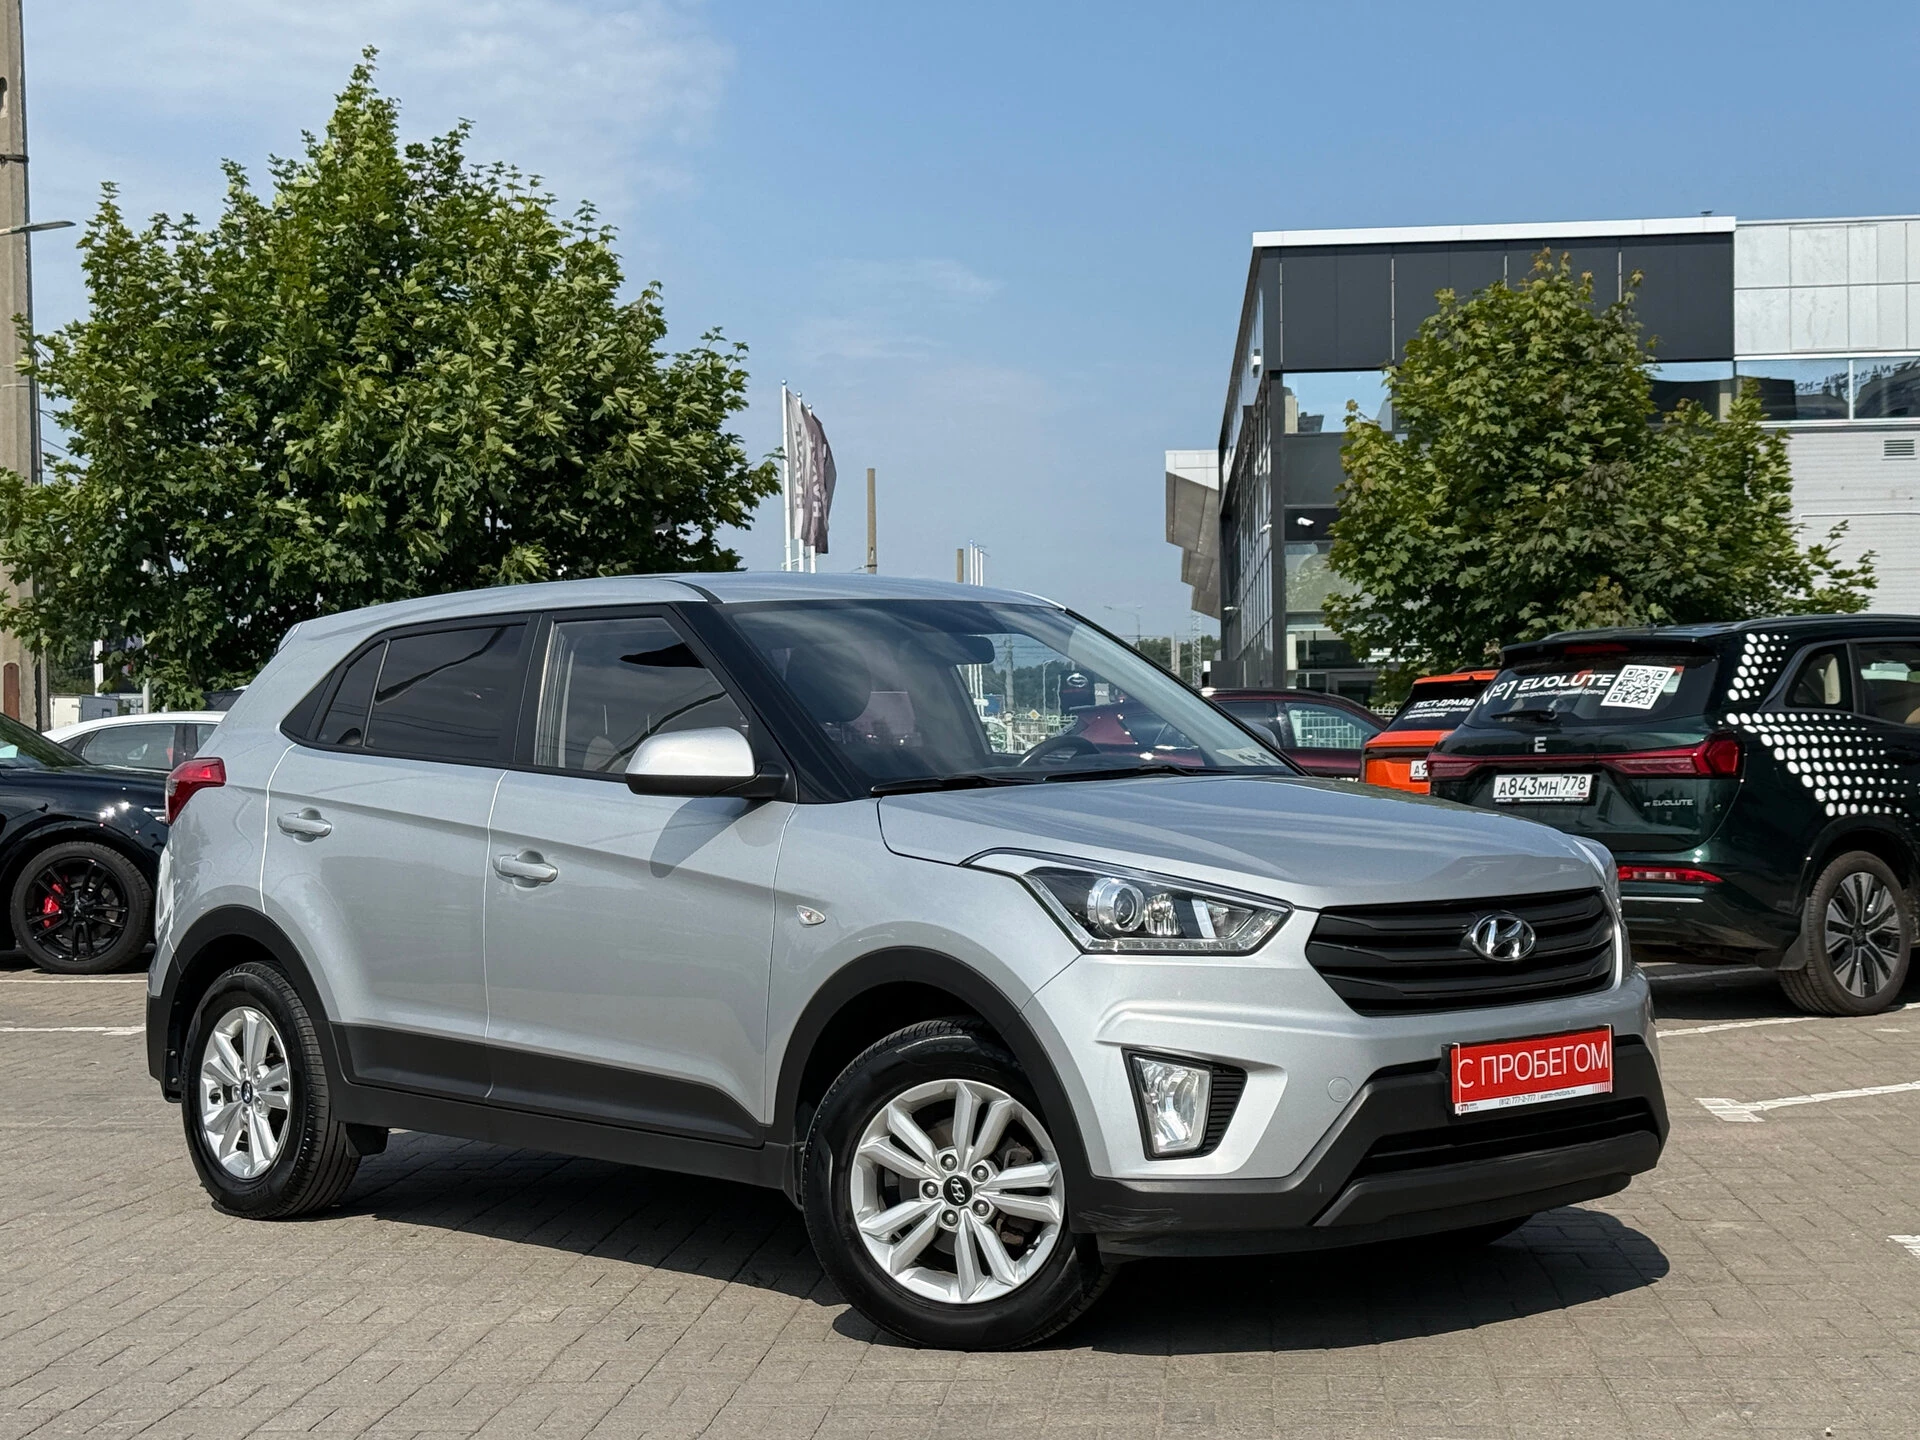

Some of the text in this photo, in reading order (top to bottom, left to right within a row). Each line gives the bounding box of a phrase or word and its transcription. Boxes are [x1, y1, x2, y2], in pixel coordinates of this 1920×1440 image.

[1518, 674, 1616, 691] EVOLUTE
[1414, 697, 1475, 708] ТЕСТ-ДРАЙВ
[1498, 776, 1587, 796] А843МН 778
[1652, 799, 1693, 807] EVOLUTE
[1457, 1041, 1609, 1088] С ПРОБЕГОМ
